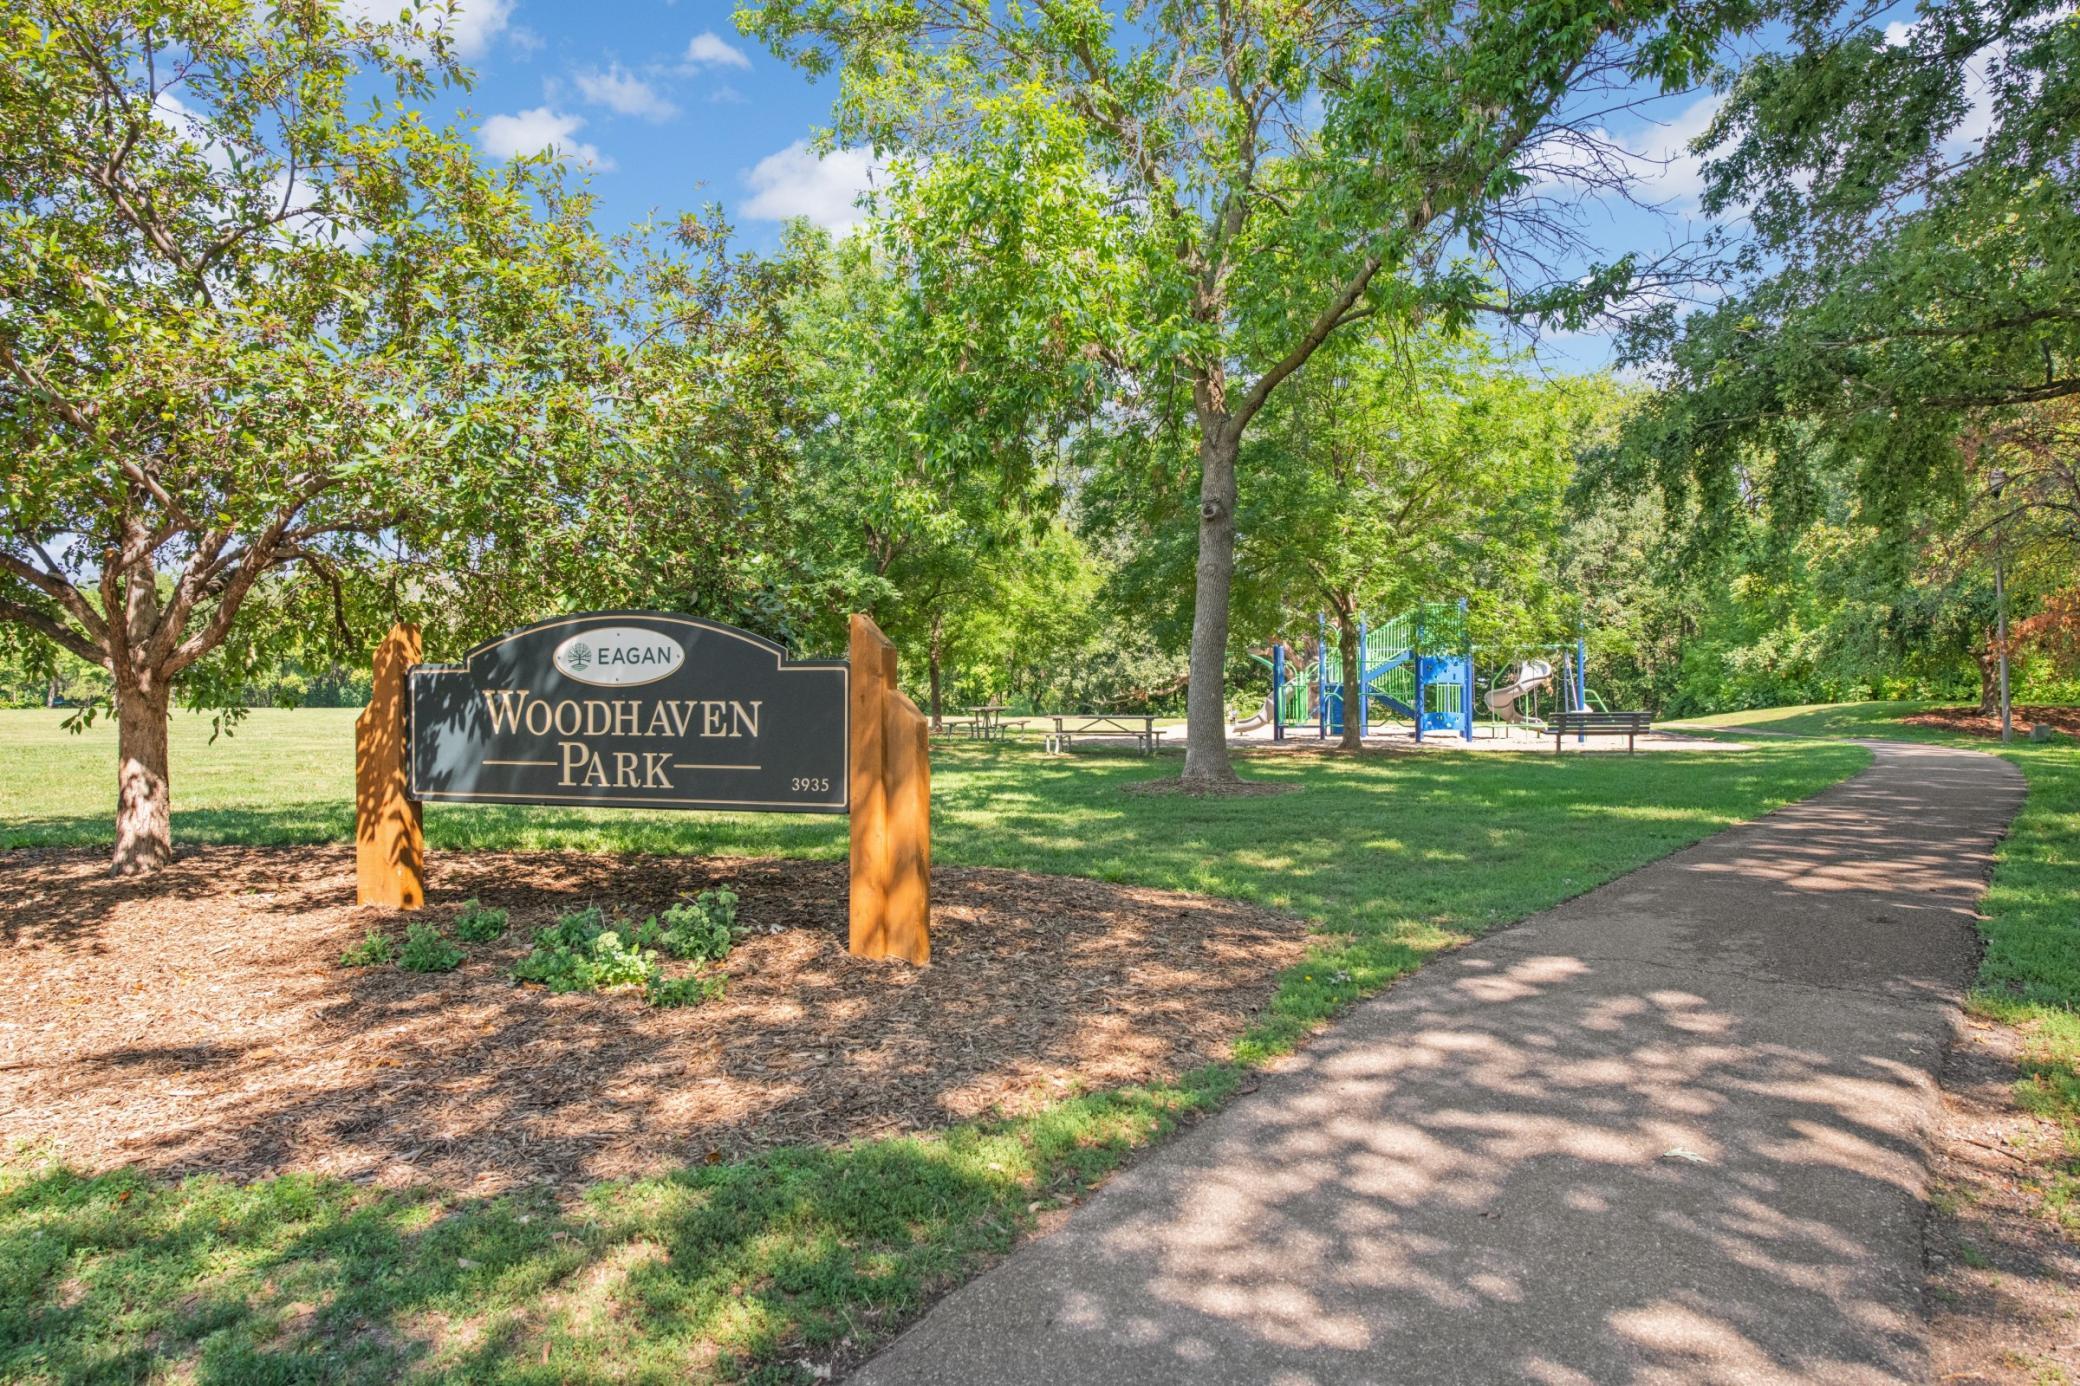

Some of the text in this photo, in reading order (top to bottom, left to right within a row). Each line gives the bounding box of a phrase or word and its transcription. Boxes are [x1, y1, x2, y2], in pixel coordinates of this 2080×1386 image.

[598, 646, 671, 665] EAGAN
[482, 689, 762, 738] WOODHAVEN
[557, 741, 674, 789] PARK
[791, 777, 830, 793] 3935
